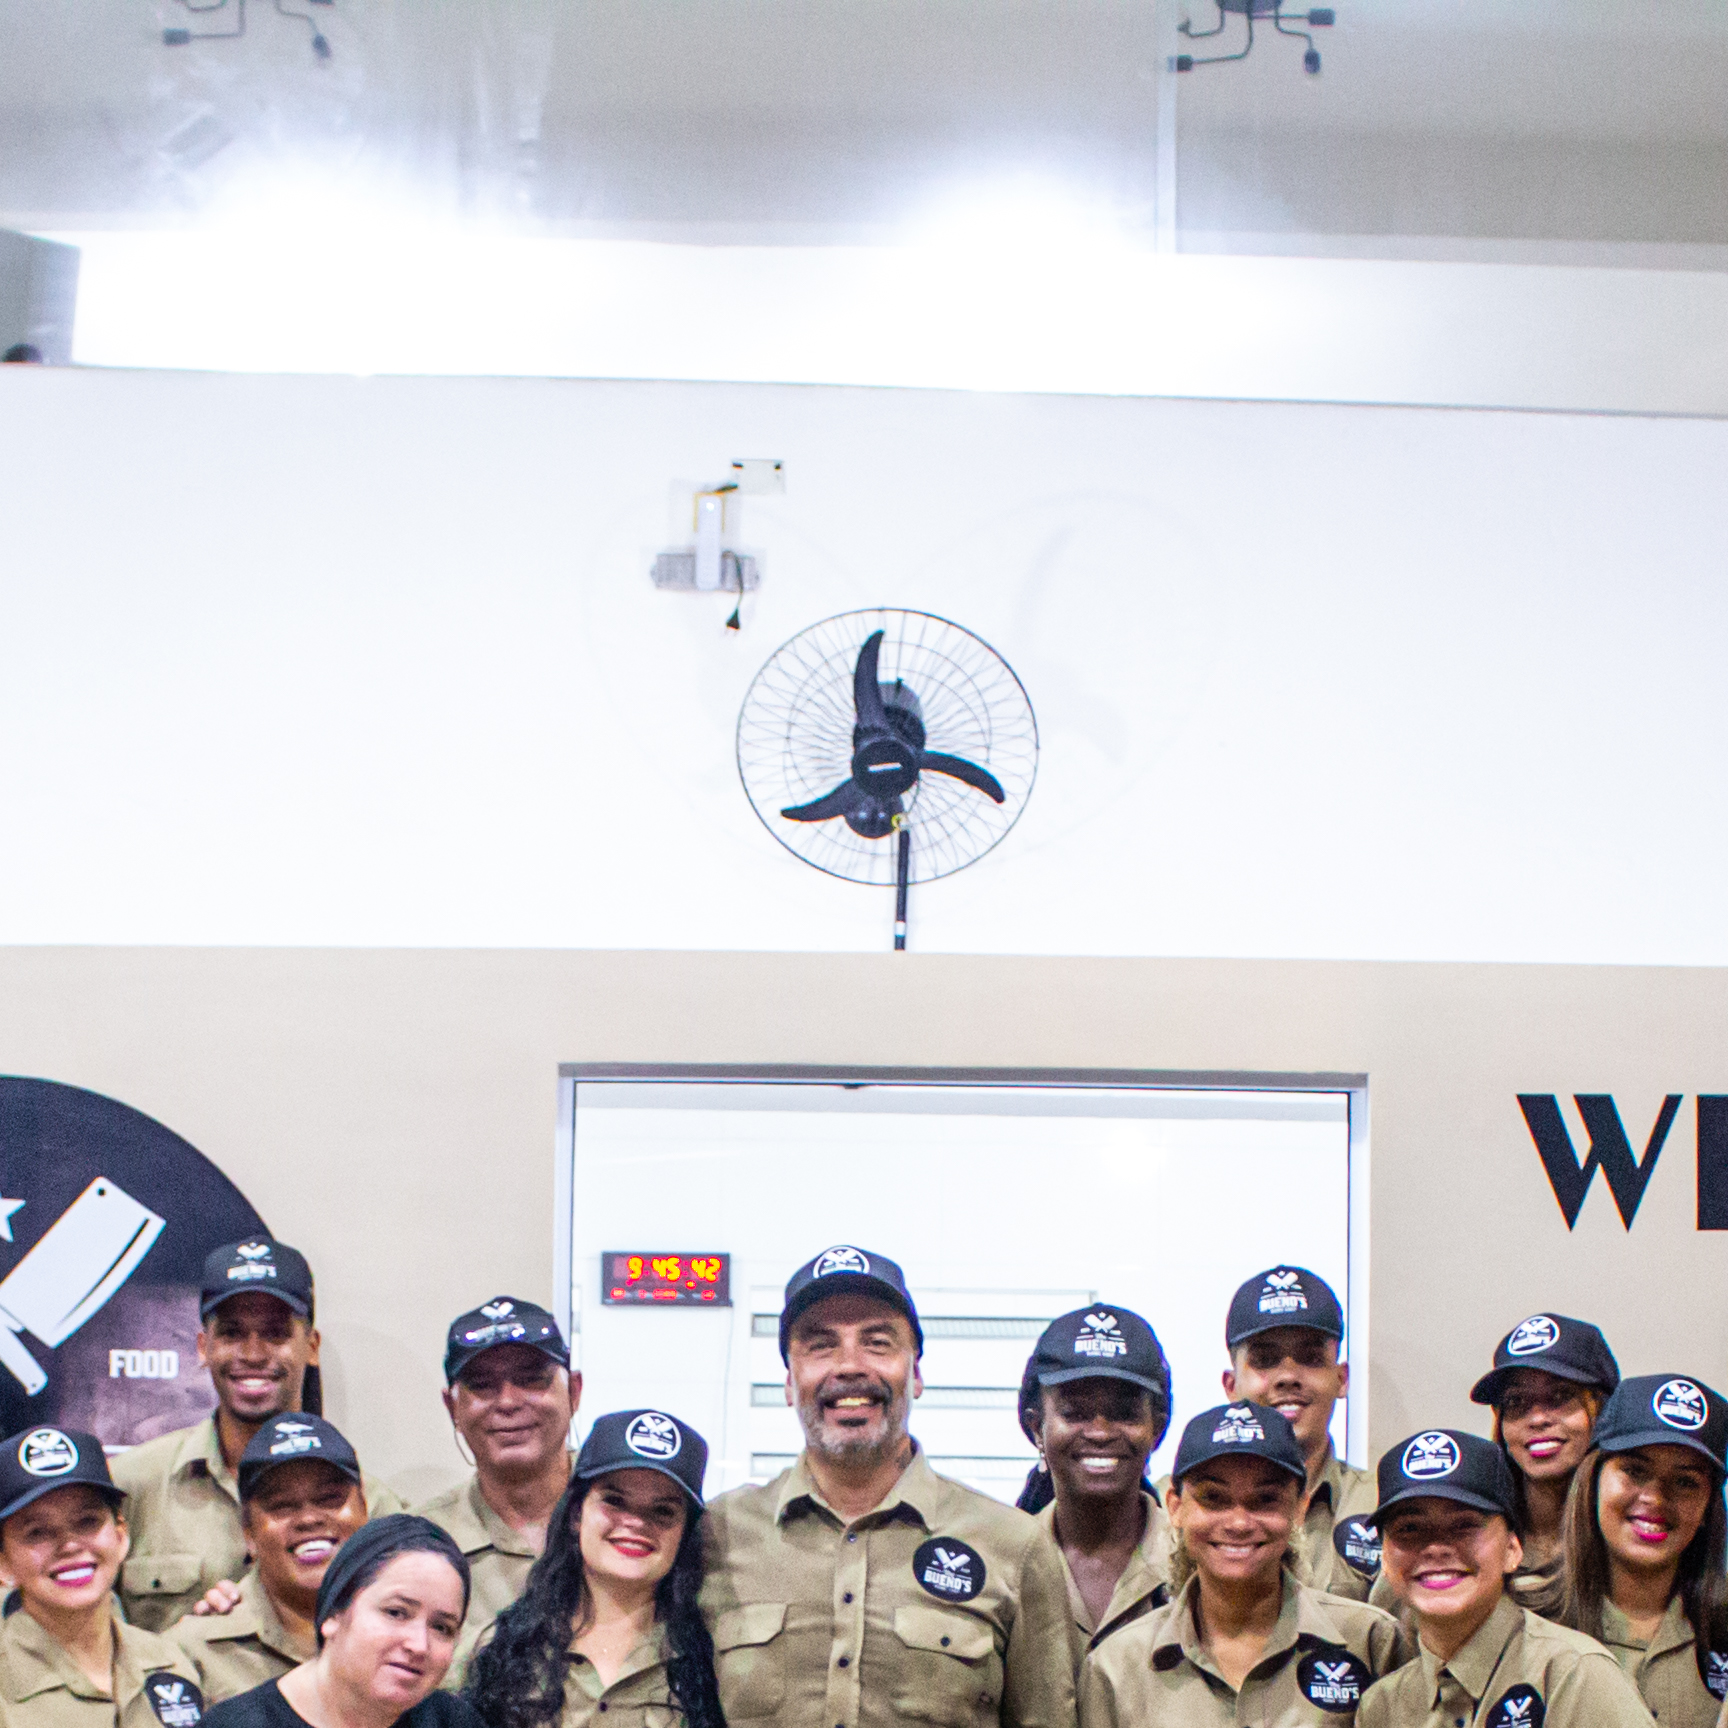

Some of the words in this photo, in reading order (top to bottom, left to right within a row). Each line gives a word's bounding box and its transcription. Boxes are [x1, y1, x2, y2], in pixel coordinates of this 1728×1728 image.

[1258, 1296, 1308, 1312] BUENO'S
[1073, 1338, 1128, 1355] BUENO'S
[108, 1348, 179, 1379] FOOD
[1212, 1425, 1265, 1443] BUENO'S
[1345, 1544, 1383, 1561] BUENO'
[923, 1569, 972, 1593] BUENO'S
[1310, 1685, 1360, 1699] BUENO'S
